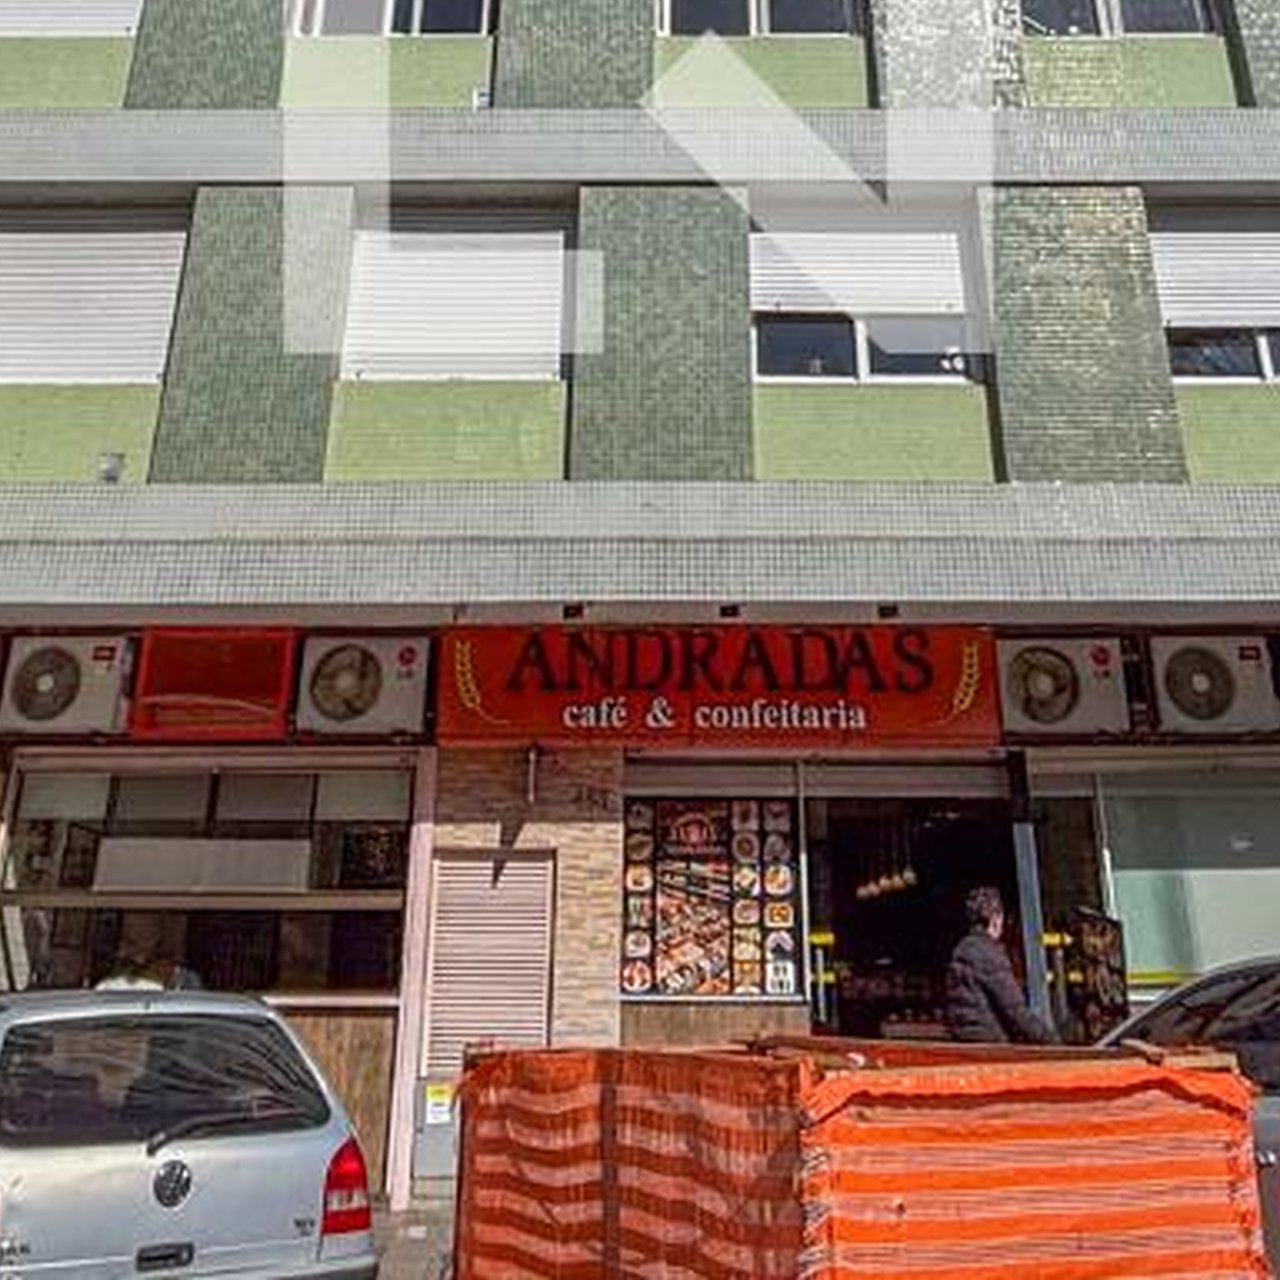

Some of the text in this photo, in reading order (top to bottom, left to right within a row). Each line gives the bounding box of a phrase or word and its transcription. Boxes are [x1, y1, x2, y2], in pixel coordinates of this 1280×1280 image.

[505, 626, 936, 694] ANDRADAS
[562, 696, 867, 730] café & confeitaria
